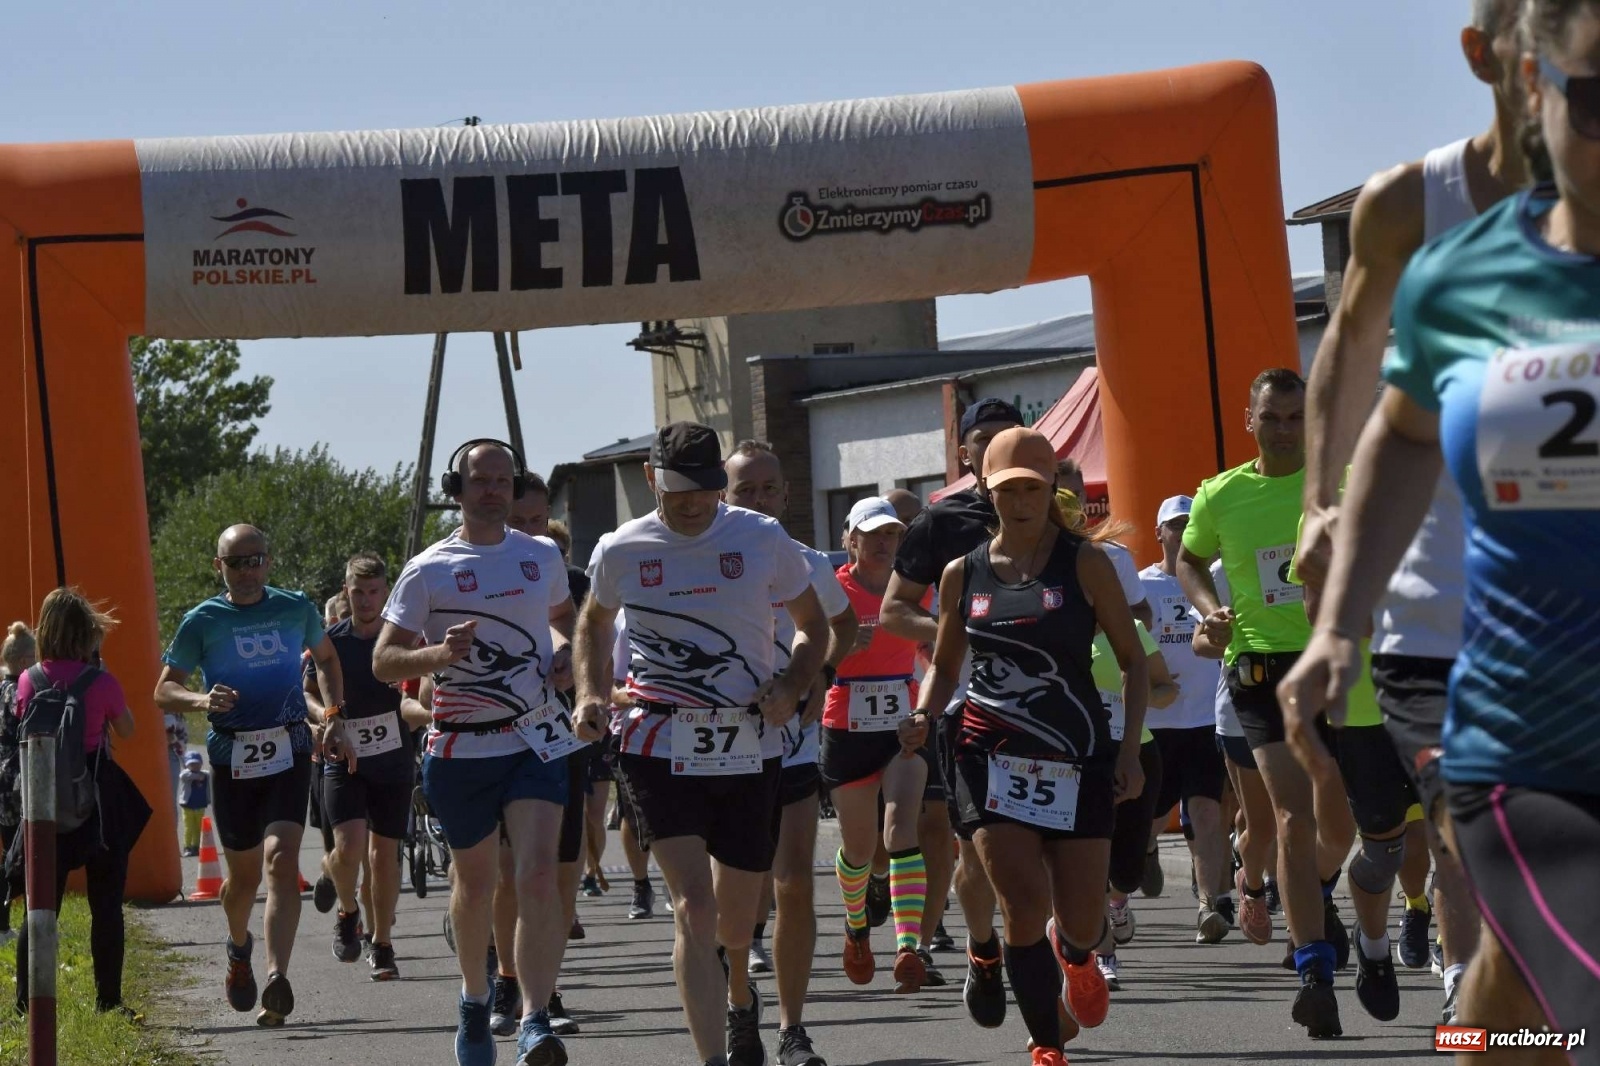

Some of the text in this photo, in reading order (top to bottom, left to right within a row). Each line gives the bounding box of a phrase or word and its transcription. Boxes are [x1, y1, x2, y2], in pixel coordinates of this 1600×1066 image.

[819, 179, 979, 200] Elektroniczny pomiar czasu
[816, 198, 986, 230] ZmierzymyCzas.pl
[400, 166, 701, 294] META
[193, 247, 316, 266] MARATONY
[192, 268, 317, 285] POLSKIE.PL
[1504, 350, 1600, 383] COLO
[1163, 596, 1189, 604] COLOU
[1173, 604, 1188, 622] 2
[865, 694, 899, 716] 13
[678, 712, 724, 724] COLOUR
[358, 725, 388, 745] 39
[693, 725, 740, 755] 37
[244, 741, 277, 764] 29
[1007, 774, 1056, 807] 35
